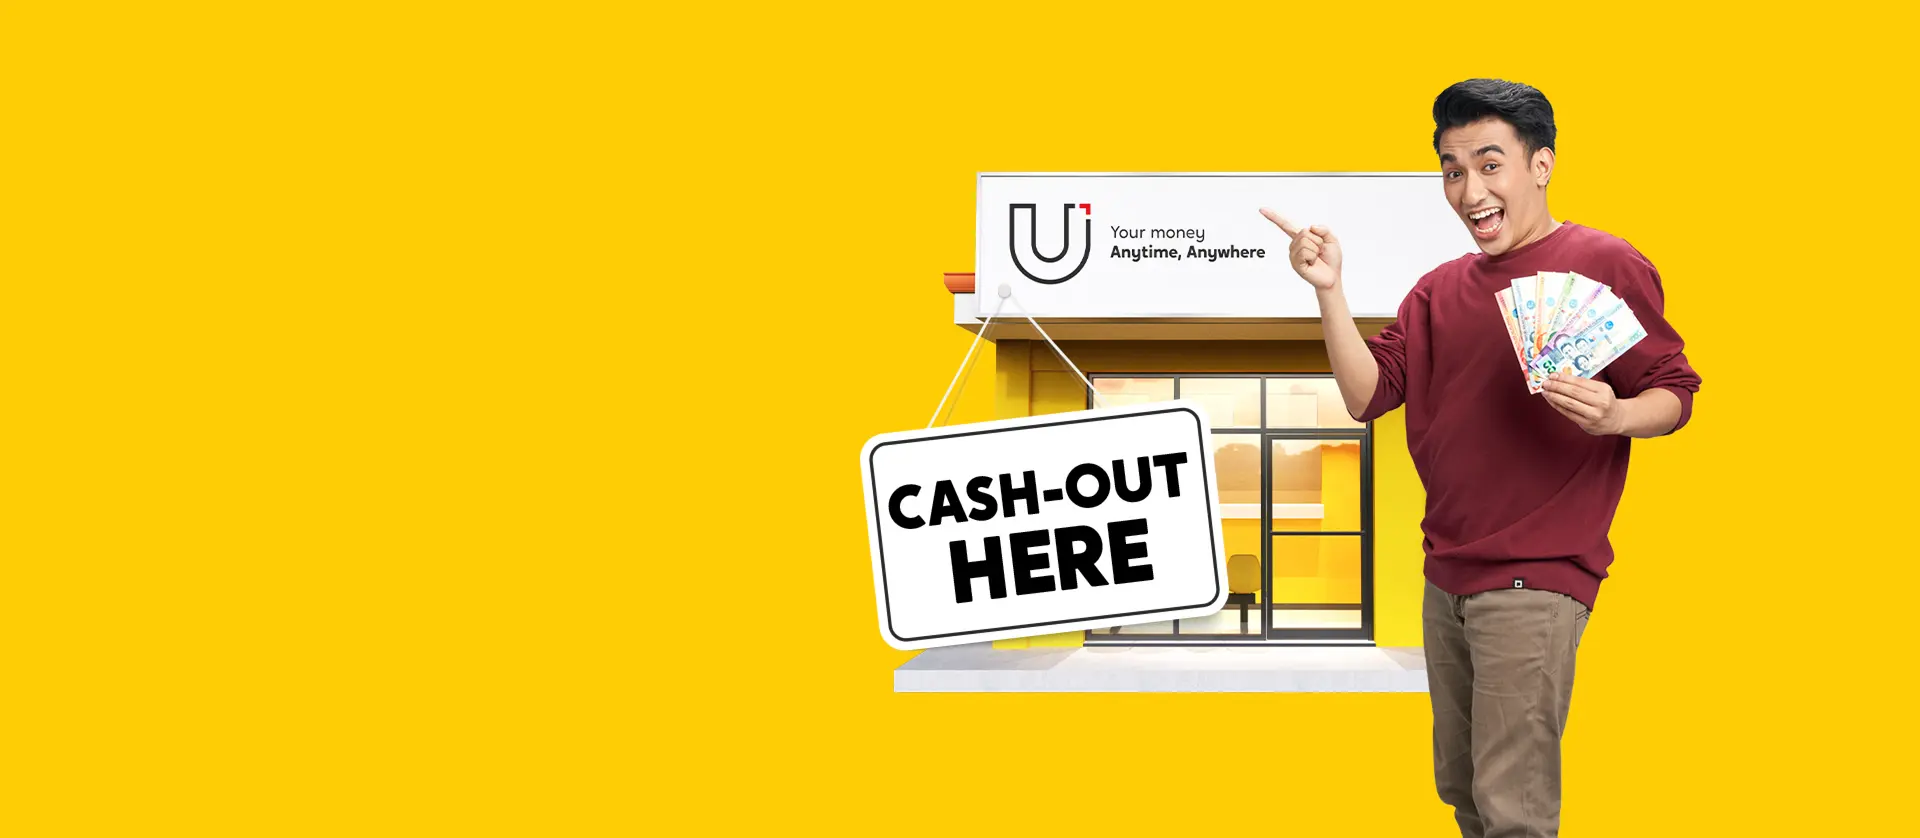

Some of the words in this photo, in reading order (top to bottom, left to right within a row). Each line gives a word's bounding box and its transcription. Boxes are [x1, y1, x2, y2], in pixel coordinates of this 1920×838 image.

[1110, 244, 1182, 262] Anytime,
[1187, 244, 1266, 262] Anywhere
[1111, 226, 1146, 239] Your
[1150, 228, 1205, 243] money
[889, 452, 1187, 529] CASH-OUT
[949, 518, 1154, 604] HERE
